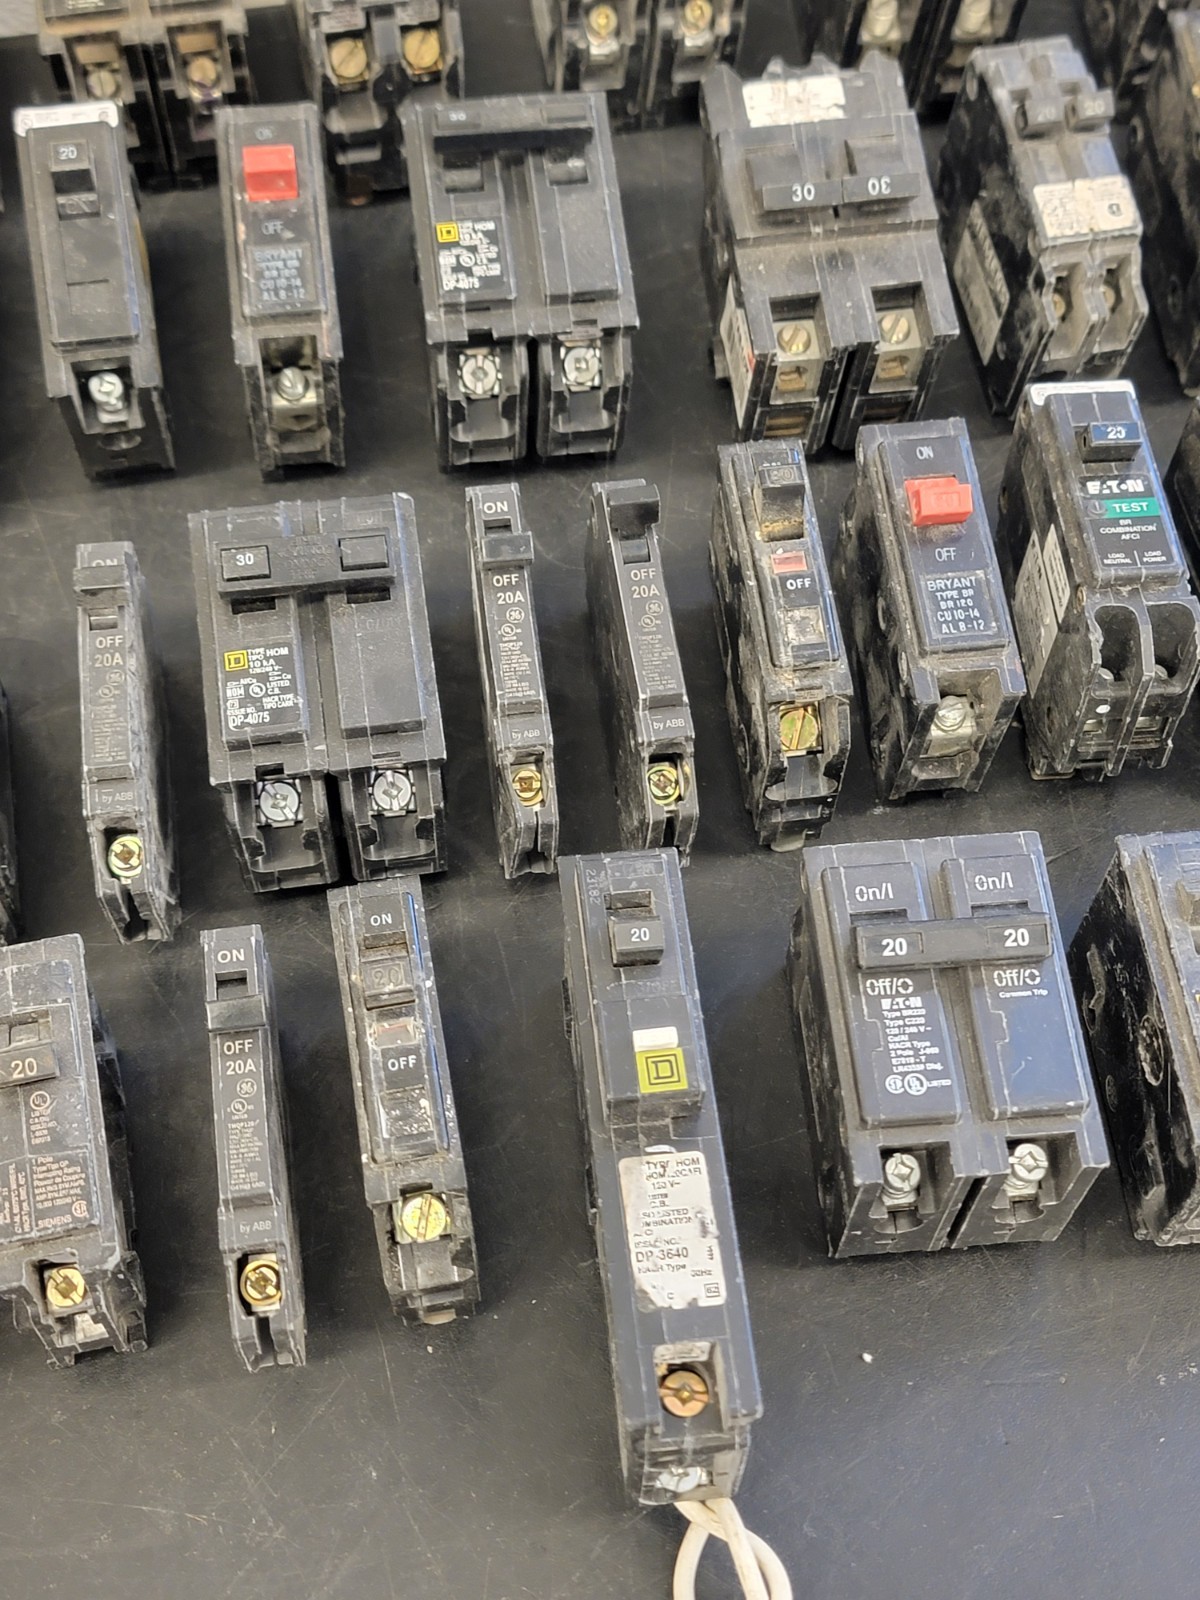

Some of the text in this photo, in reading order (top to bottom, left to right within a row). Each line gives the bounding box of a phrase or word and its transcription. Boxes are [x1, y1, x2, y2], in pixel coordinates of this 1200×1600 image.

[58, 144, 78, 160] 20
[791, 182, 816, 203] 30
[262, 220, 284, 236] OFF
[916, 446, 934, 460] ON
[483, 500, 509, 514] ON
[1112, 501, 1149, 513] TEST
[1121, 532, 1141, 540] AFCI
[235, 552, 255, 566] 30
[934, 547, 957, 562] OFF
[492, 573, 520, 587] OFF
[630, 567, 657, 581] OFF
[786, 577, 812, 591] OFF
[926, 575, 977, 592] BRYANT
[496, 591, 526, 605] 20A
[631, 584, 661, 599] 20A
[934, 588, 975, 600] TYPE BR
[939, 600, 955, 609] BR
[936, 607, 980, 622] CU 10-14
[941, 620, 986, 635] AL 8-12
[95, 635, 124, 649] OFF
[265, 646, 289, 657] HOM
[94, 652, 124, 668] 20A
[249, 660, 261, 668] 10
[266, 680, 290, 688] LISTED
[229, 711, 270, 727] DP-4075
[653, 718, 686, 730] by ABB
[523, 728, 541, 738] ABB
[113, 790, 134, 802] ABB
[369, 912, 393, 927] ON
[630, 927, 651, 942] 20
[881, 928, 1031, 957] 20 20
[216, 948, 246, 964] ON
[373, 967, 401, 987] 20
[993, 968, 1042, 987] Off/O
[865, 977, 914, 996] Off/O
[882, 1010, 901, 1019] Type
[883, 1019, 904, 1027] Type
[223, 1039, 254, 1055] OFF
[10, 1057, 38, 1080] 20
[225, 1058, 257, 1075] 20A
[387, 1054, 418, 1072] OFF
[38, 1214, 72, 1228] SIEMENS
[239, 1220, 273, 1234] by ABB
